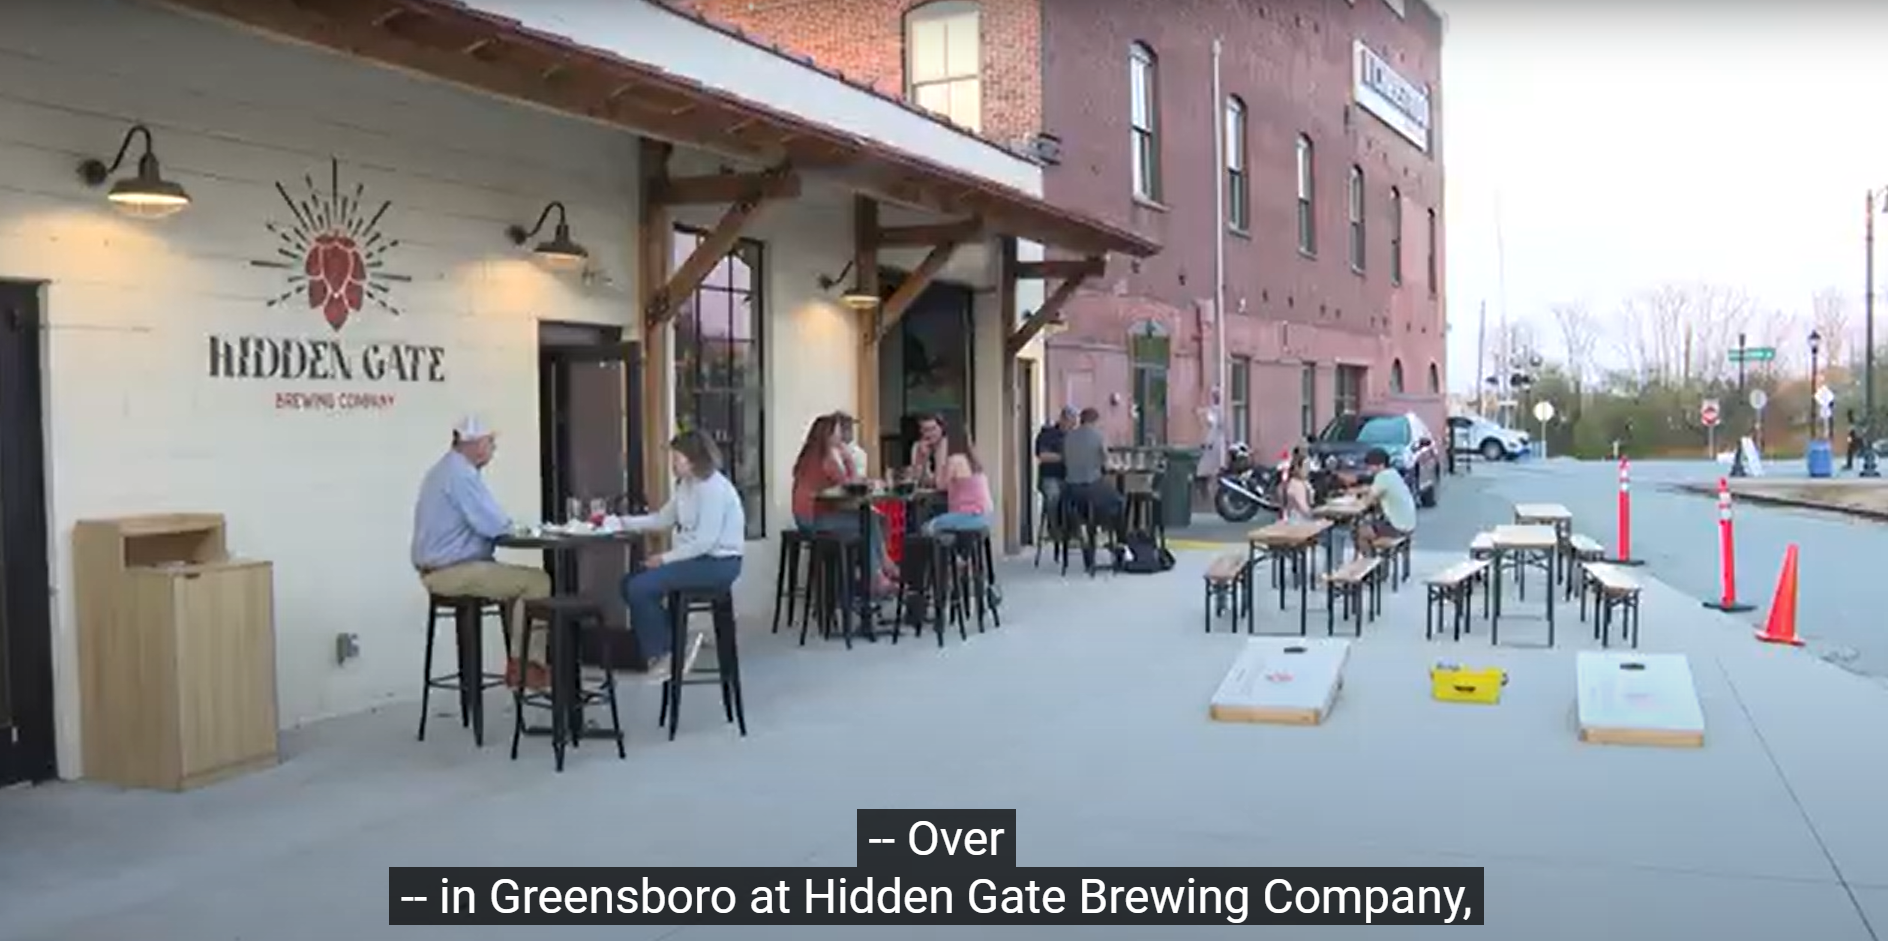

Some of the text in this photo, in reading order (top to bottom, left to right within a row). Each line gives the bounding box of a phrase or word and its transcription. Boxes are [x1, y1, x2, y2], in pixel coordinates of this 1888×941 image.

[362, 343, 446, 382] GATE
[275, 392, 395, 409] BREWING COMPANY
